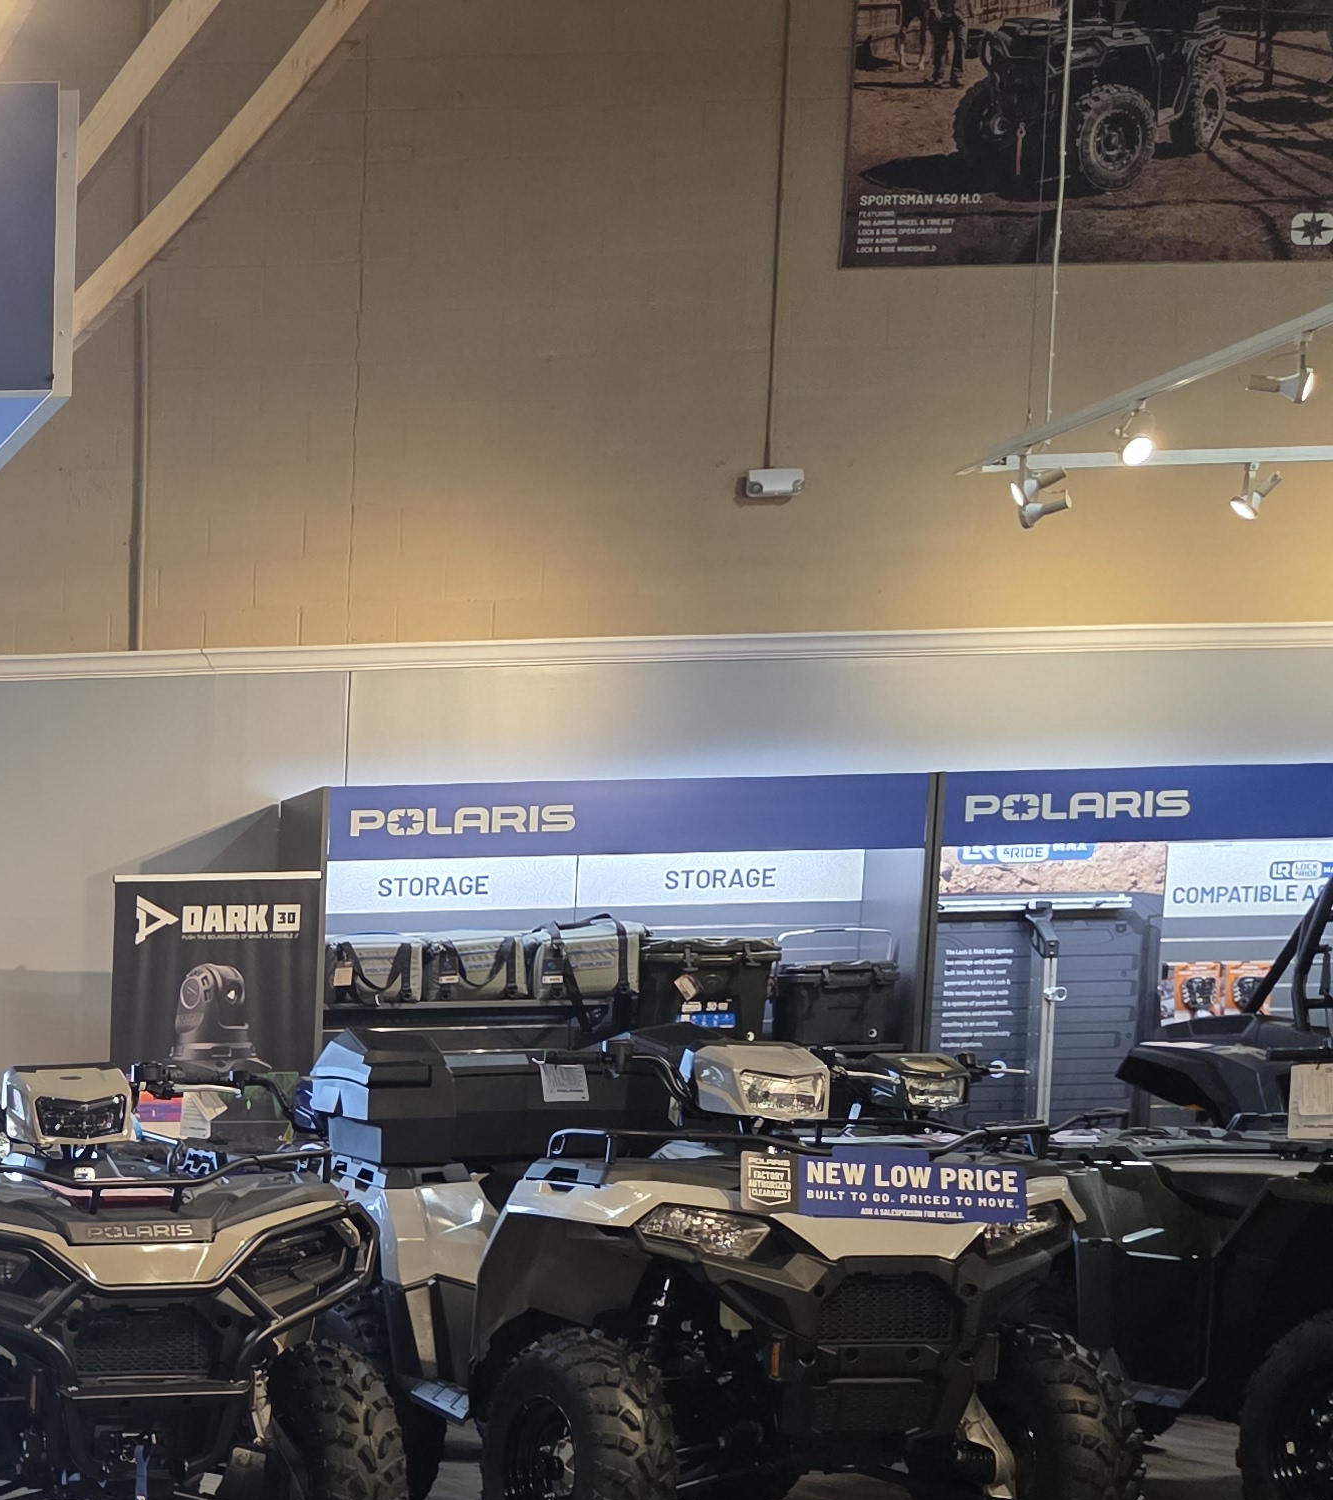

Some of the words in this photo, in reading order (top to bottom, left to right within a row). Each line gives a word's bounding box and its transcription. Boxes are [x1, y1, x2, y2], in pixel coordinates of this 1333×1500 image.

[860, 194, 933, 206] SPORTSMAN
[935, 194, 958, 204] 450
[960, 193, 983, 204] H.O.
[964, 790, 1192, 823] POLARIS
[349, 804, 576, 838] POLARIS
[377, 875, 490, 897] STORAGE
[664, 867, 776, 889] STORAGE
[1172, 885, 1298, 903] COMPATIBLE
[182, 905, 268, 932] DARK
[748, 1156, 790, 1166] POLARIS
[748, 1179, 791, 1190] AUTHORIZED
[753, 1170, 784, 1181] FACTORY
[807, 1161, 867, 1187] NEW
[874, 1164, 932, 1189] LOW
[940, 1168, 1018, 1192] PRICE
[751, 1189, 788, 1199] CLEARANCE
[807, 1190, 844, 1201] BUILT
[850, 1191, 867, 1202] TO
[873, 1193, 894, 1203] GO.
[900, 1194, 950, 1205] PRICED
[955, 1196, 972, 1206] TO
[978, 1197, 1020, 1209] MOVE.
[87, 1225, 193, 1238] POLARIS
